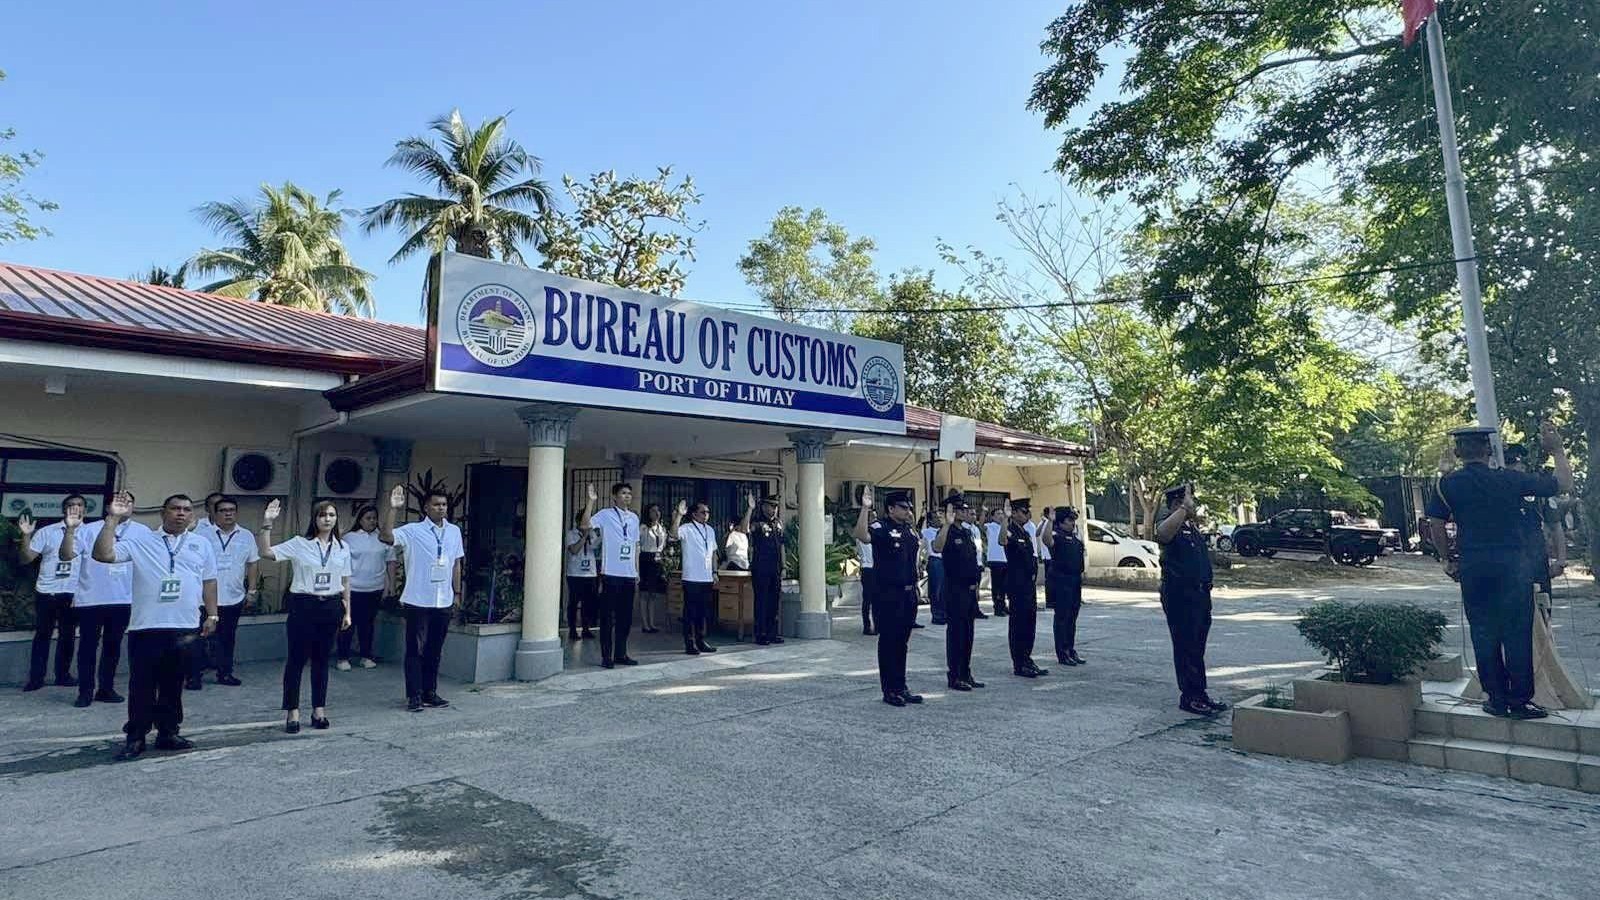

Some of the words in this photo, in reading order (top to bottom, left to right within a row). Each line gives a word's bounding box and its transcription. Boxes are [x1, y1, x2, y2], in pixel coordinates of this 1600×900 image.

[460, 288, 499, 321] DEPARTMENT
[502, 290, 514, 299] OF
[514, 297, 534, 331] FINANCE
[461, 330, 486, 361] BUREAU
[500, 342, 531, 366] CUSTOMS
[542, 286, 686, 364] BUREAU
[698, 317, 739, 371] OF
[748, 326, 859, 390] CUSTOMS
[638, 371, 699, 395] PORT
[704, 380, 732, 399] OF
[737, 384, 796, 407] LIMAY
